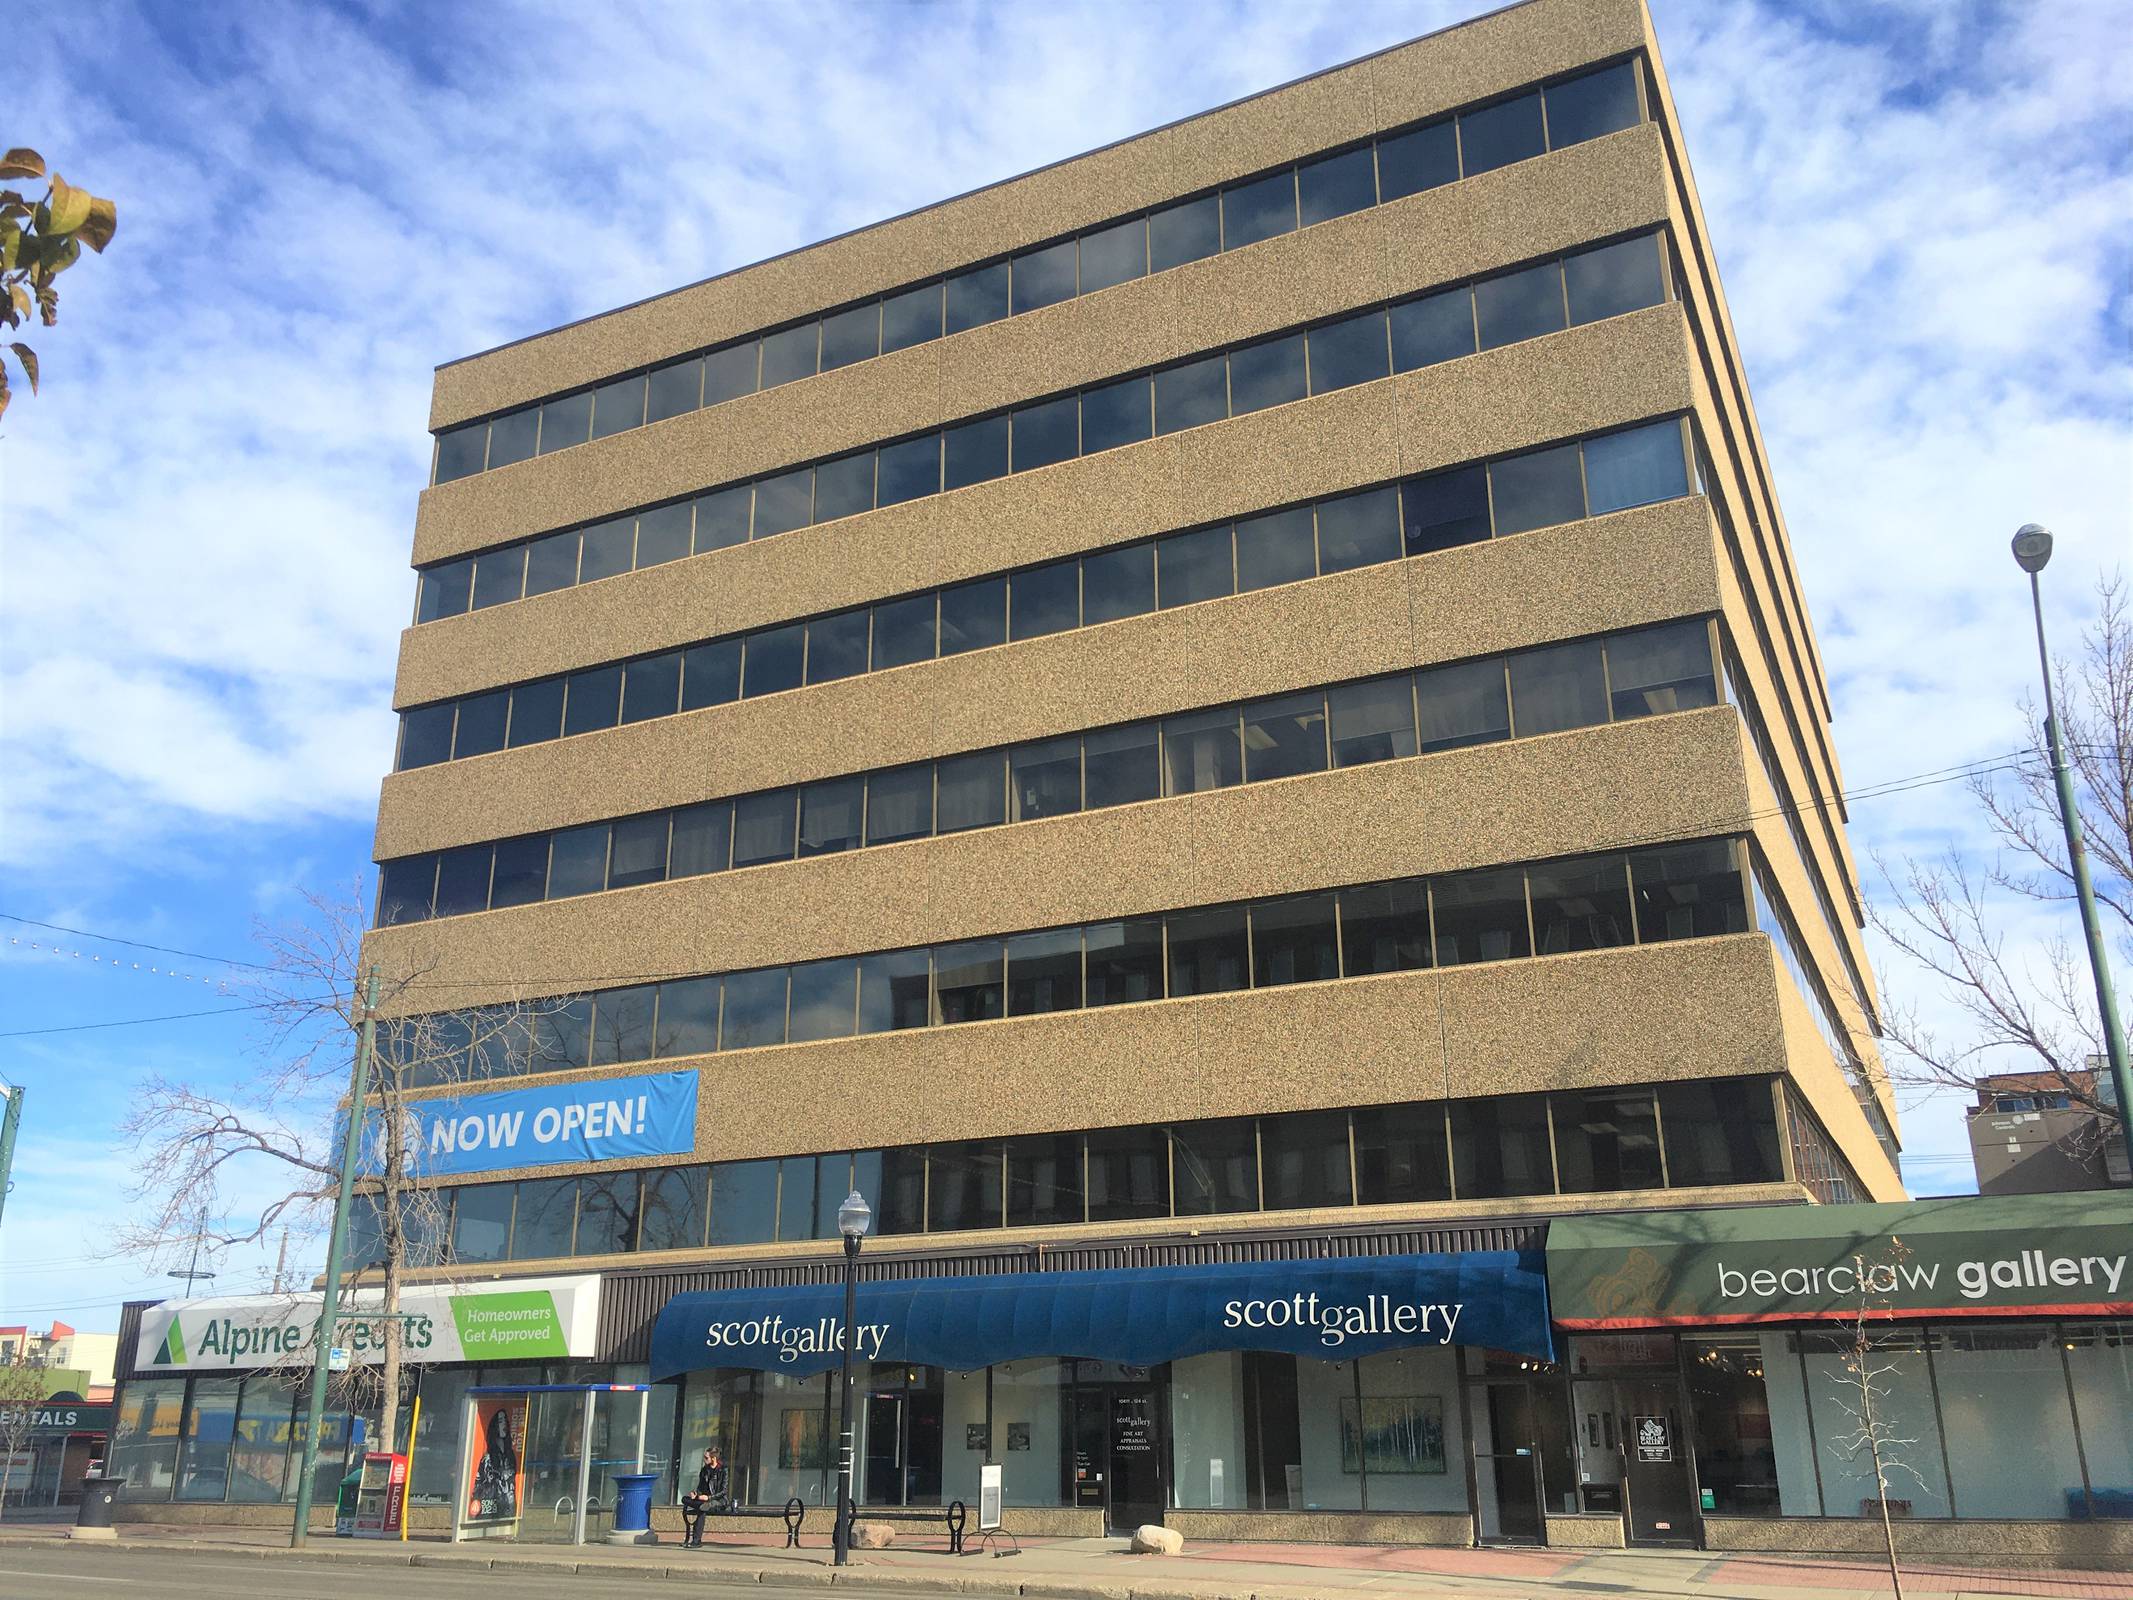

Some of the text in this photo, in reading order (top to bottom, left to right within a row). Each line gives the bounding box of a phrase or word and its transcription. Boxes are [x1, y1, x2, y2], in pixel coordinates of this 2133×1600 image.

[431, 1096, 647, 1154] NOW OPEN!
[1717, 1249, 2127, 1299] bearclaw gallery
[464, 1325, 550, 1345] Get Approved
[467, 1308, 551, 1323] Homeowners
[198, 1319, 301, 1364] Alpine
[389, 1486, 402, 1525] FREE
